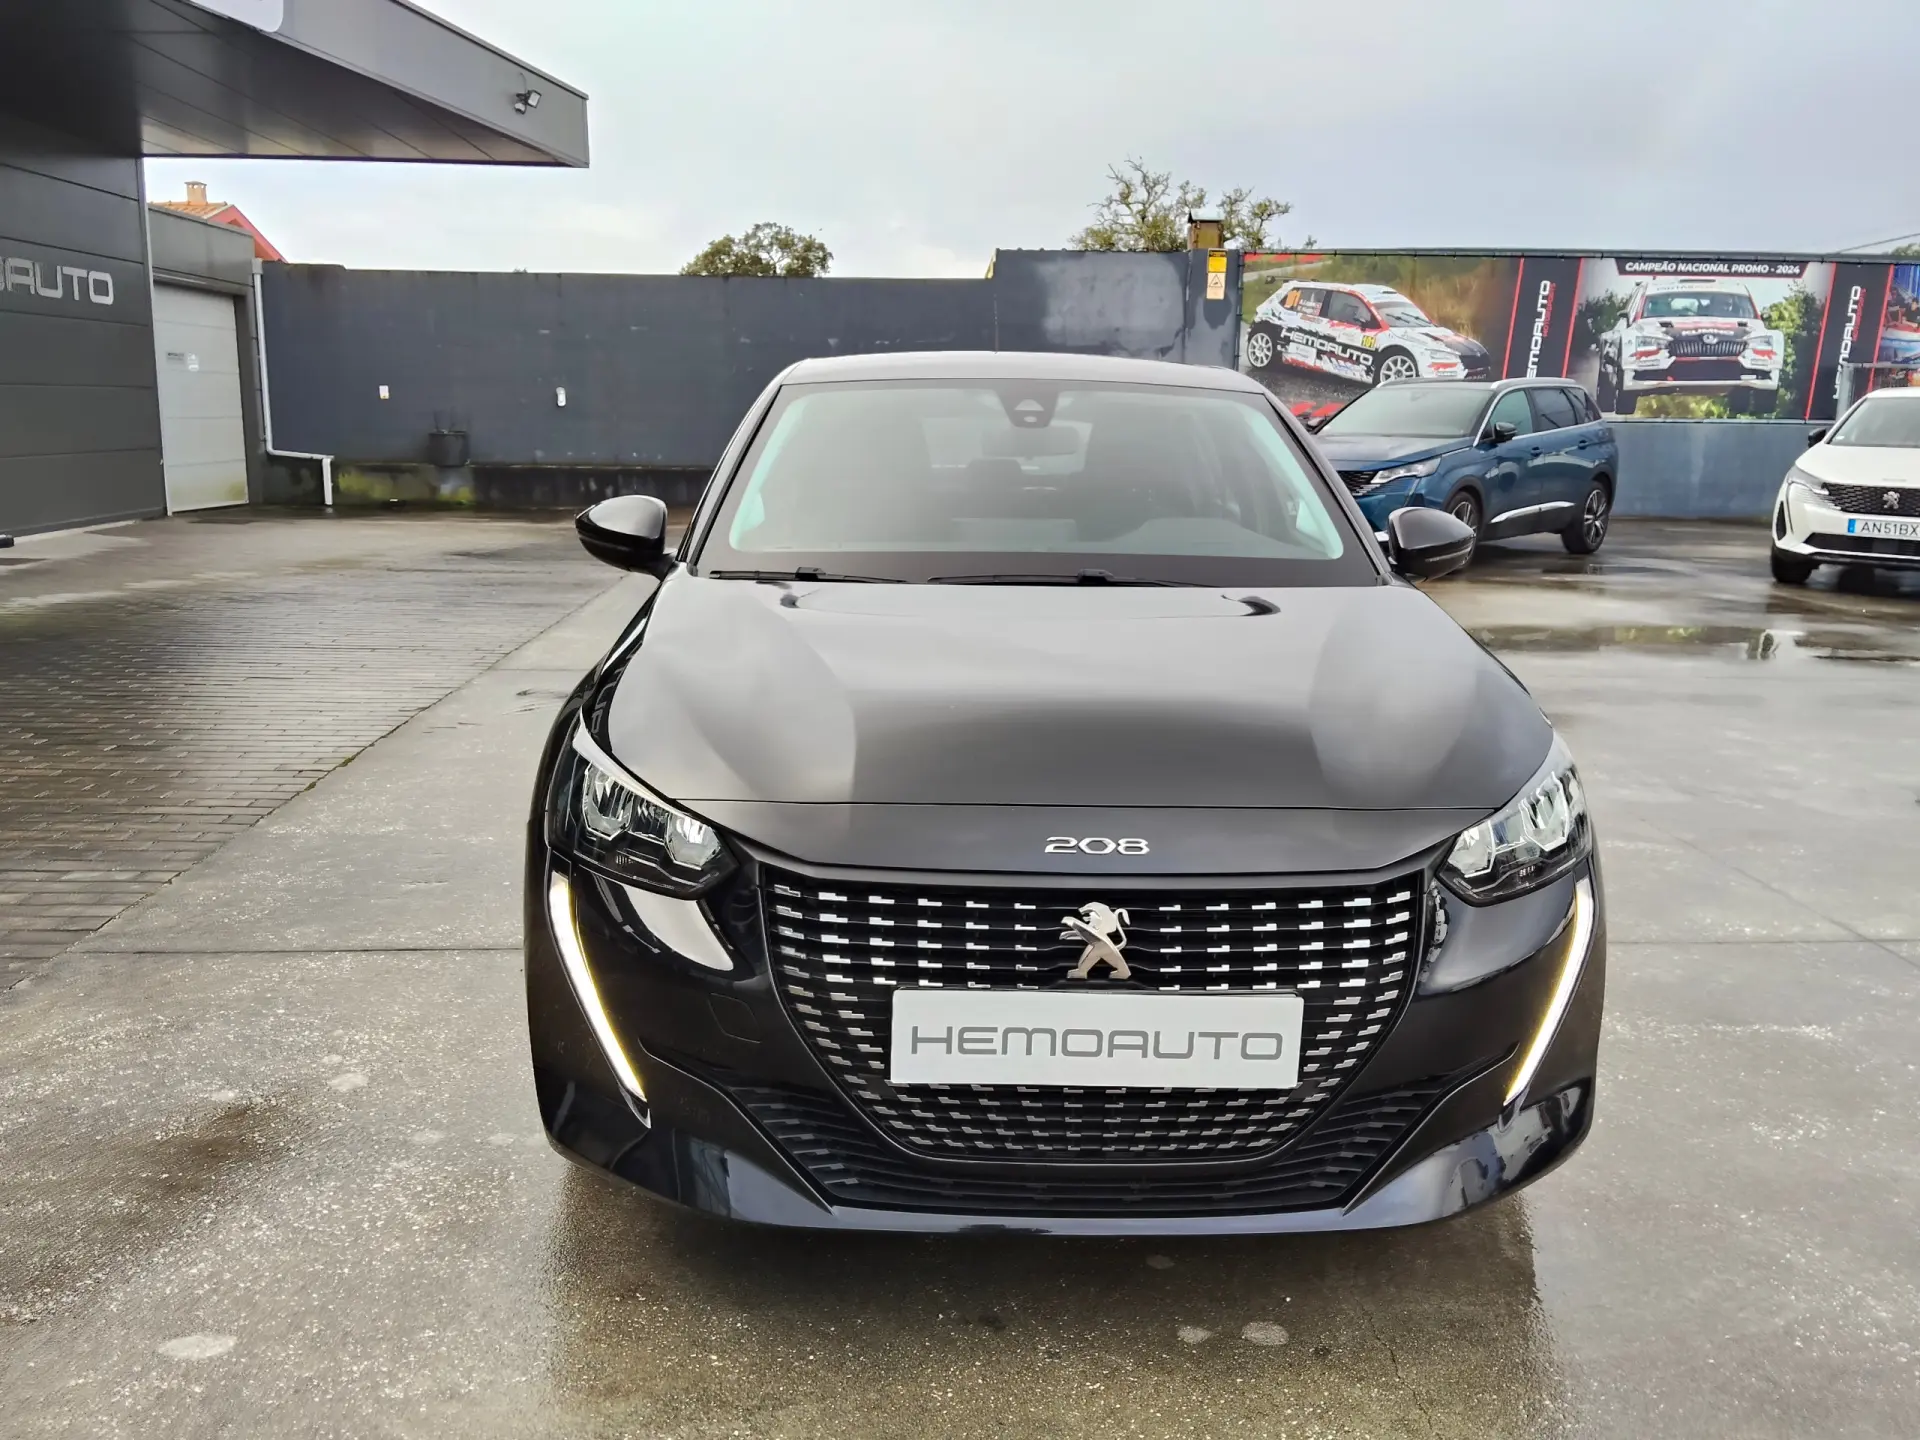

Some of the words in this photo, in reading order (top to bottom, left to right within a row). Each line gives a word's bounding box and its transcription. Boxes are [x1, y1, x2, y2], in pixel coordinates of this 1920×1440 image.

[1625, 260, 1675, 272] CAMPEÃO
[1677, 262, 1729, 273] NACIONAL
[1731, 263, 1769, 273] PROMO
[1775, 264, 1801, 274] 2024
[0, 257, 114, 305] AUTO
[1280, 328, 1373, 366] HEMOAUTO
[1361, 335, 1377, 349] 101
[1044, 836, 1151, 855] 208
[910, 1025, 1284, 1061] HEMOAUTO
